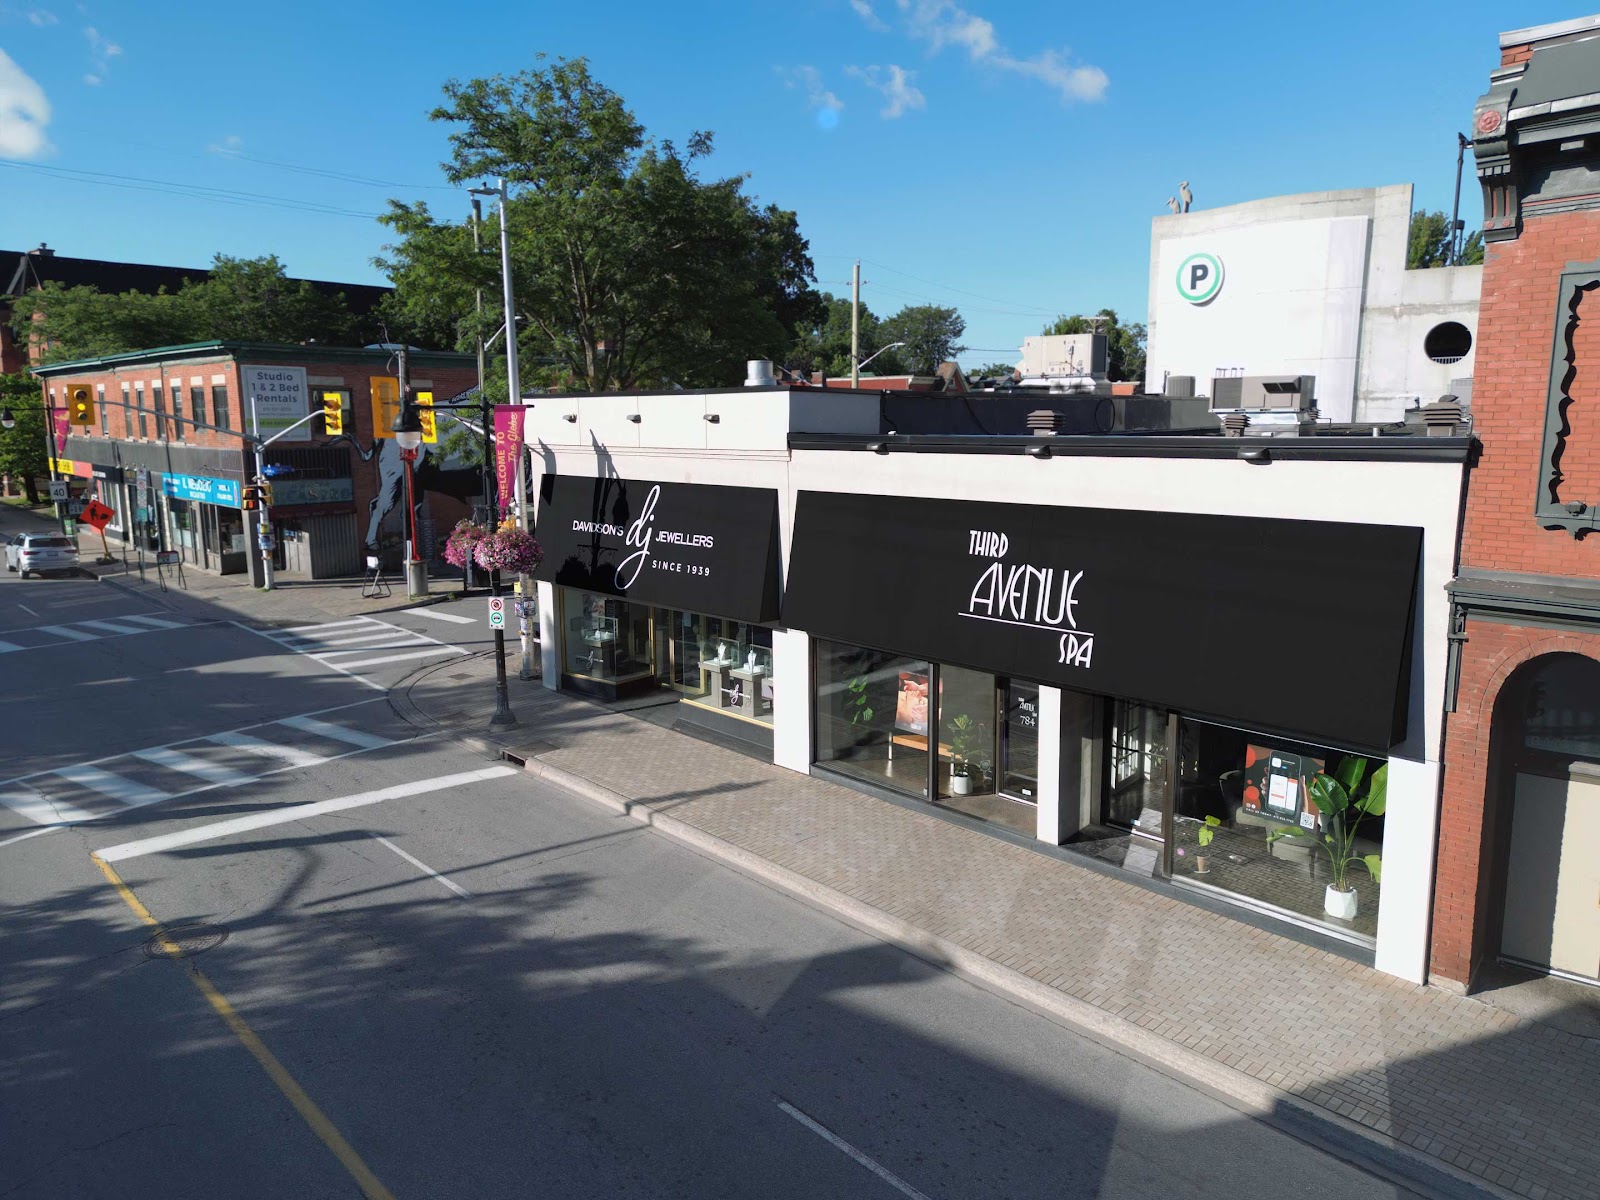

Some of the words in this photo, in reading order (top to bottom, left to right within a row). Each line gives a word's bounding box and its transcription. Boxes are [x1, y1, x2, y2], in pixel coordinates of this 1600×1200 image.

[1190, 263, 1209, 290] P
[257, 372, 293, 381] Studio
[251, 383, 256, 391] 1
[269, 384, 276, 392] 2
[279, 384, 300, 392] Bed
[257, 394, 298, 403] Rentals
[507, 412, 521, 441] Glebe
[496, 431, 505, 445] TO
[507, 443, 519, 463] The
[53, 488, 65, 497] 40
[572, 519, 624, 537] DAVIDSON'S
[614, 484, 661, 590] dj
[655, 530, 714, 548] JEWELLERS
[969, 529, 1009, 558] THIRD
[652, 559, 682, 573] SINCE
[686, 564, 711, 577] 1939
[969, 561, 1084, 629] AVENUE
[1058, 633, 1094, 669] SPA
[1020, 715, 1035, 727] 784
